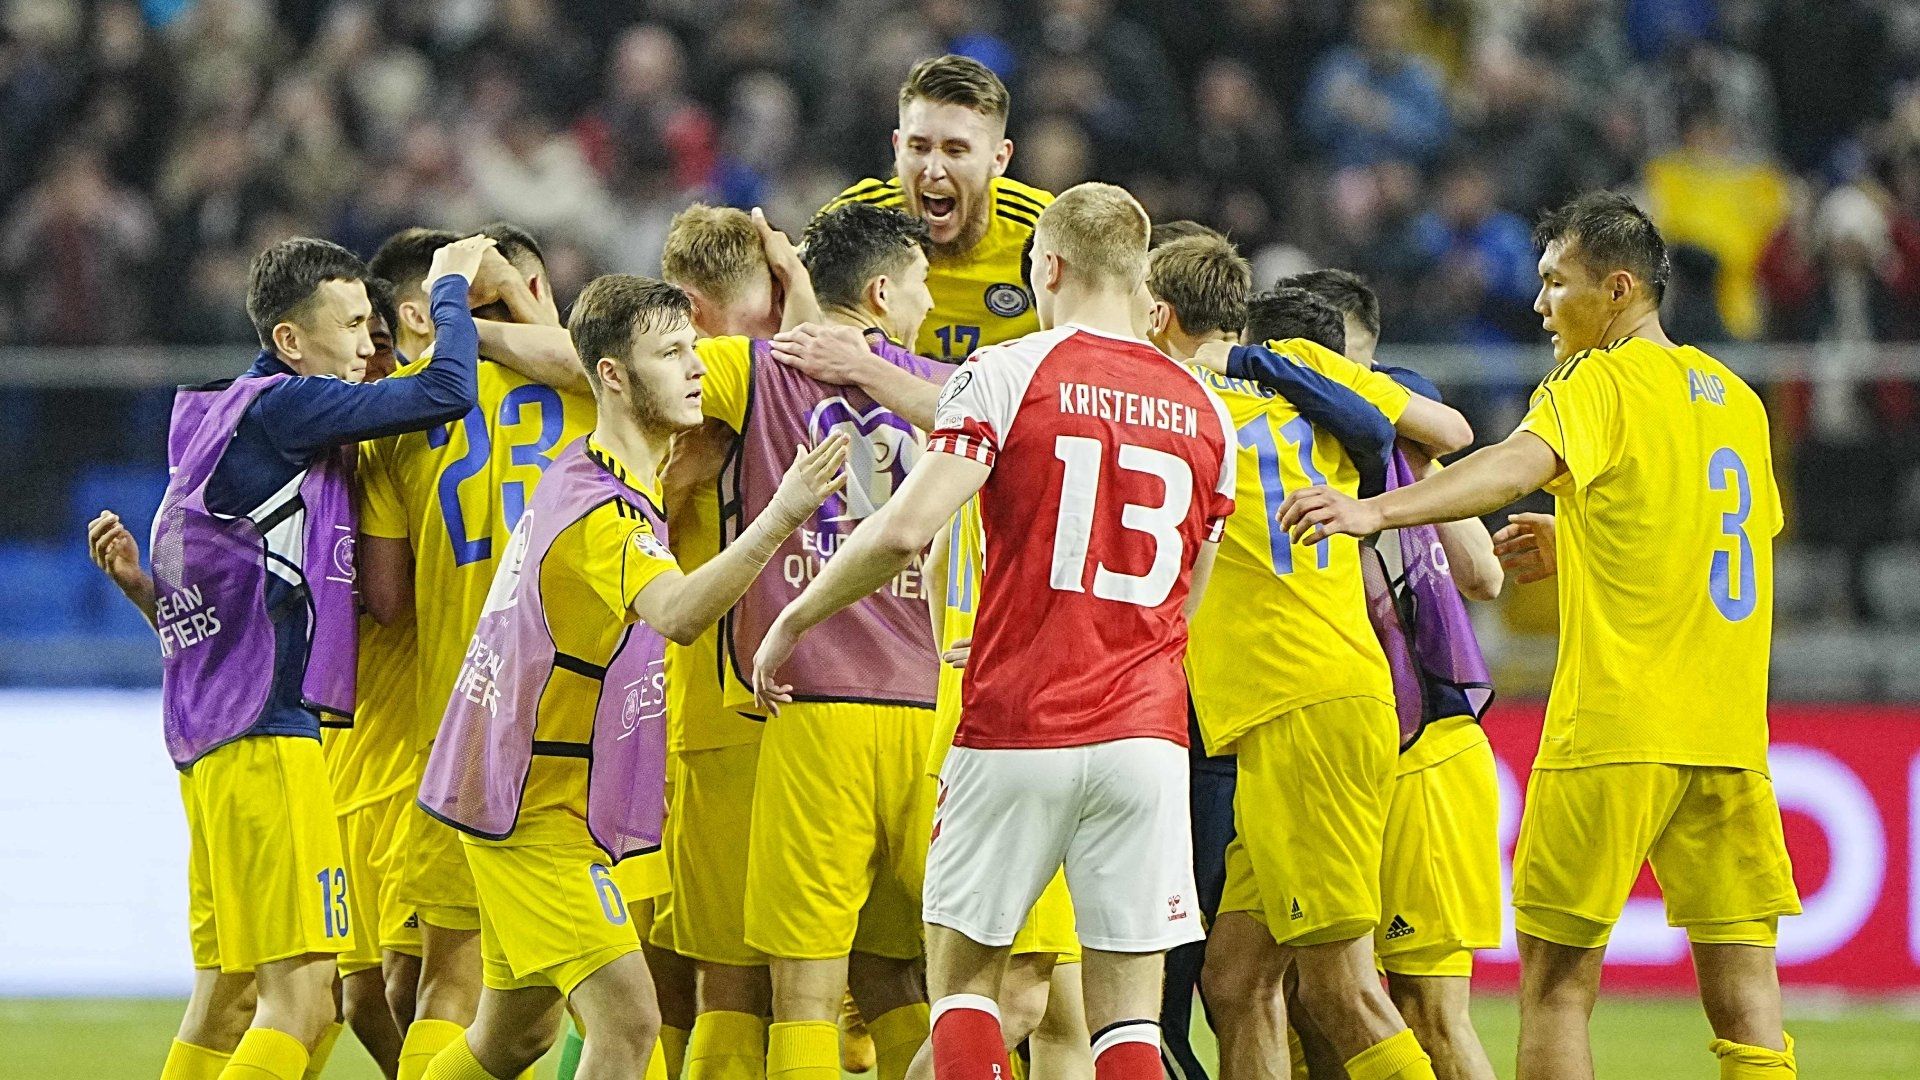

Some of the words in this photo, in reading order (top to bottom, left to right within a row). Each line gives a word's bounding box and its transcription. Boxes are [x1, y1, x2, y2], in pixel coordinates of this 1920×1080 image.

[1059, 382, 1198, 438] KRISTENSEN
[426, 383, 564, 567] 23
[1049, 434, 1194, 608] 13
[1236, 412, 1329, 575] 11
[1708, 447, 1757, 622] 3
[317, 867, 350, 938] 13
[589, 863, 627, 926] 6
[1385, 926, 1415, 940] adidas
